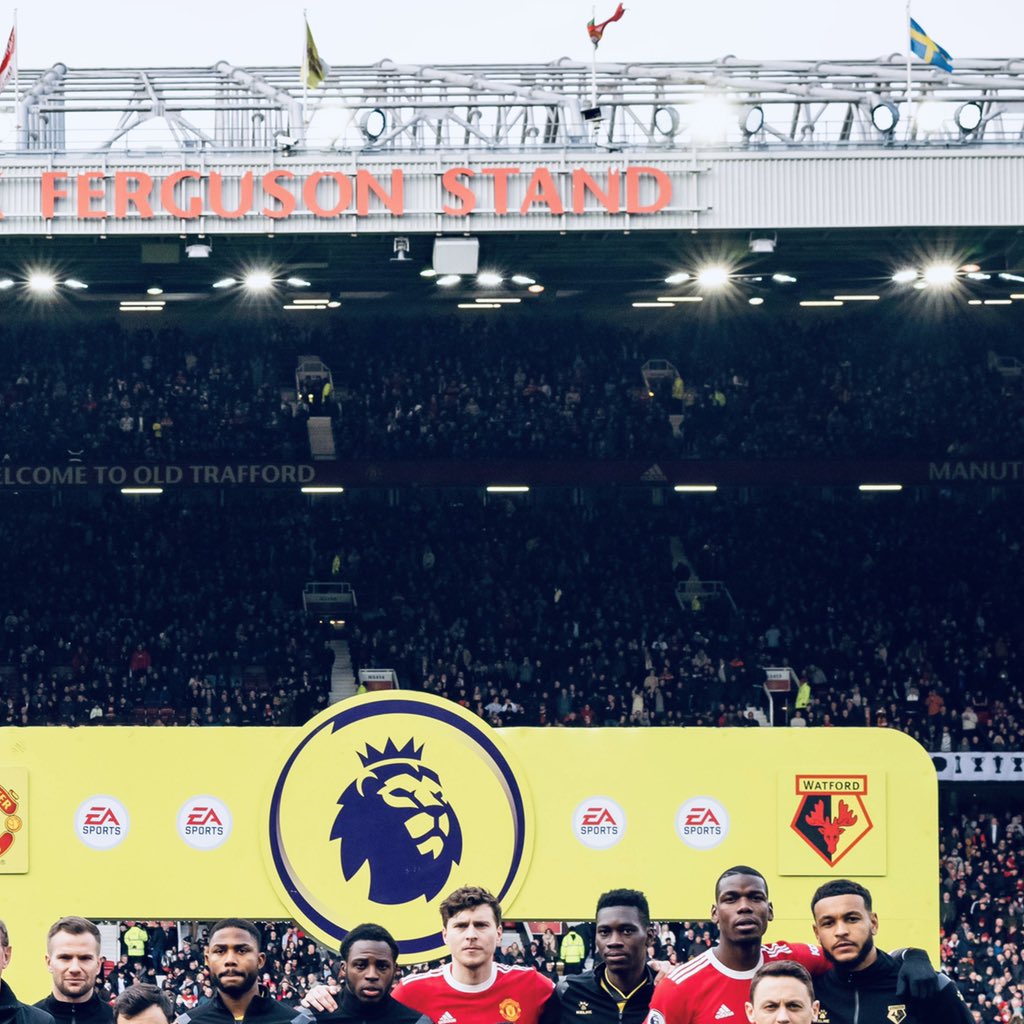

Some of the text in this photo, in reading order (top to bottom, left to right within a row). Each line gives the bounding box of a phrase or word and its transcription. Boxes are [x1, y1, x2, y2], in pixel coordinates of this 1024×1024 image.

[41, 169, 404, 220] FERGUSON
[441, 166, 672, 216] STAND
[93, 466, 127, 484] TO
[134, 466, 183, 484] OLD
[189, 465, 316, 483] TRAFFORD
[803, 781, 860, 791] WATFORD
[84, 807, 120, 826] EA
[186, 807, 222, 826] EA
[581, 807, 617, 826] EA
[684, 807, 720, 826] EA
[82, 826, 121, 836] SPORTS
[185, 826, 223, 835] SPORTS
[581, 826, 618, 835] SPORTS
[684, 826, 721, 835] SPORTS
